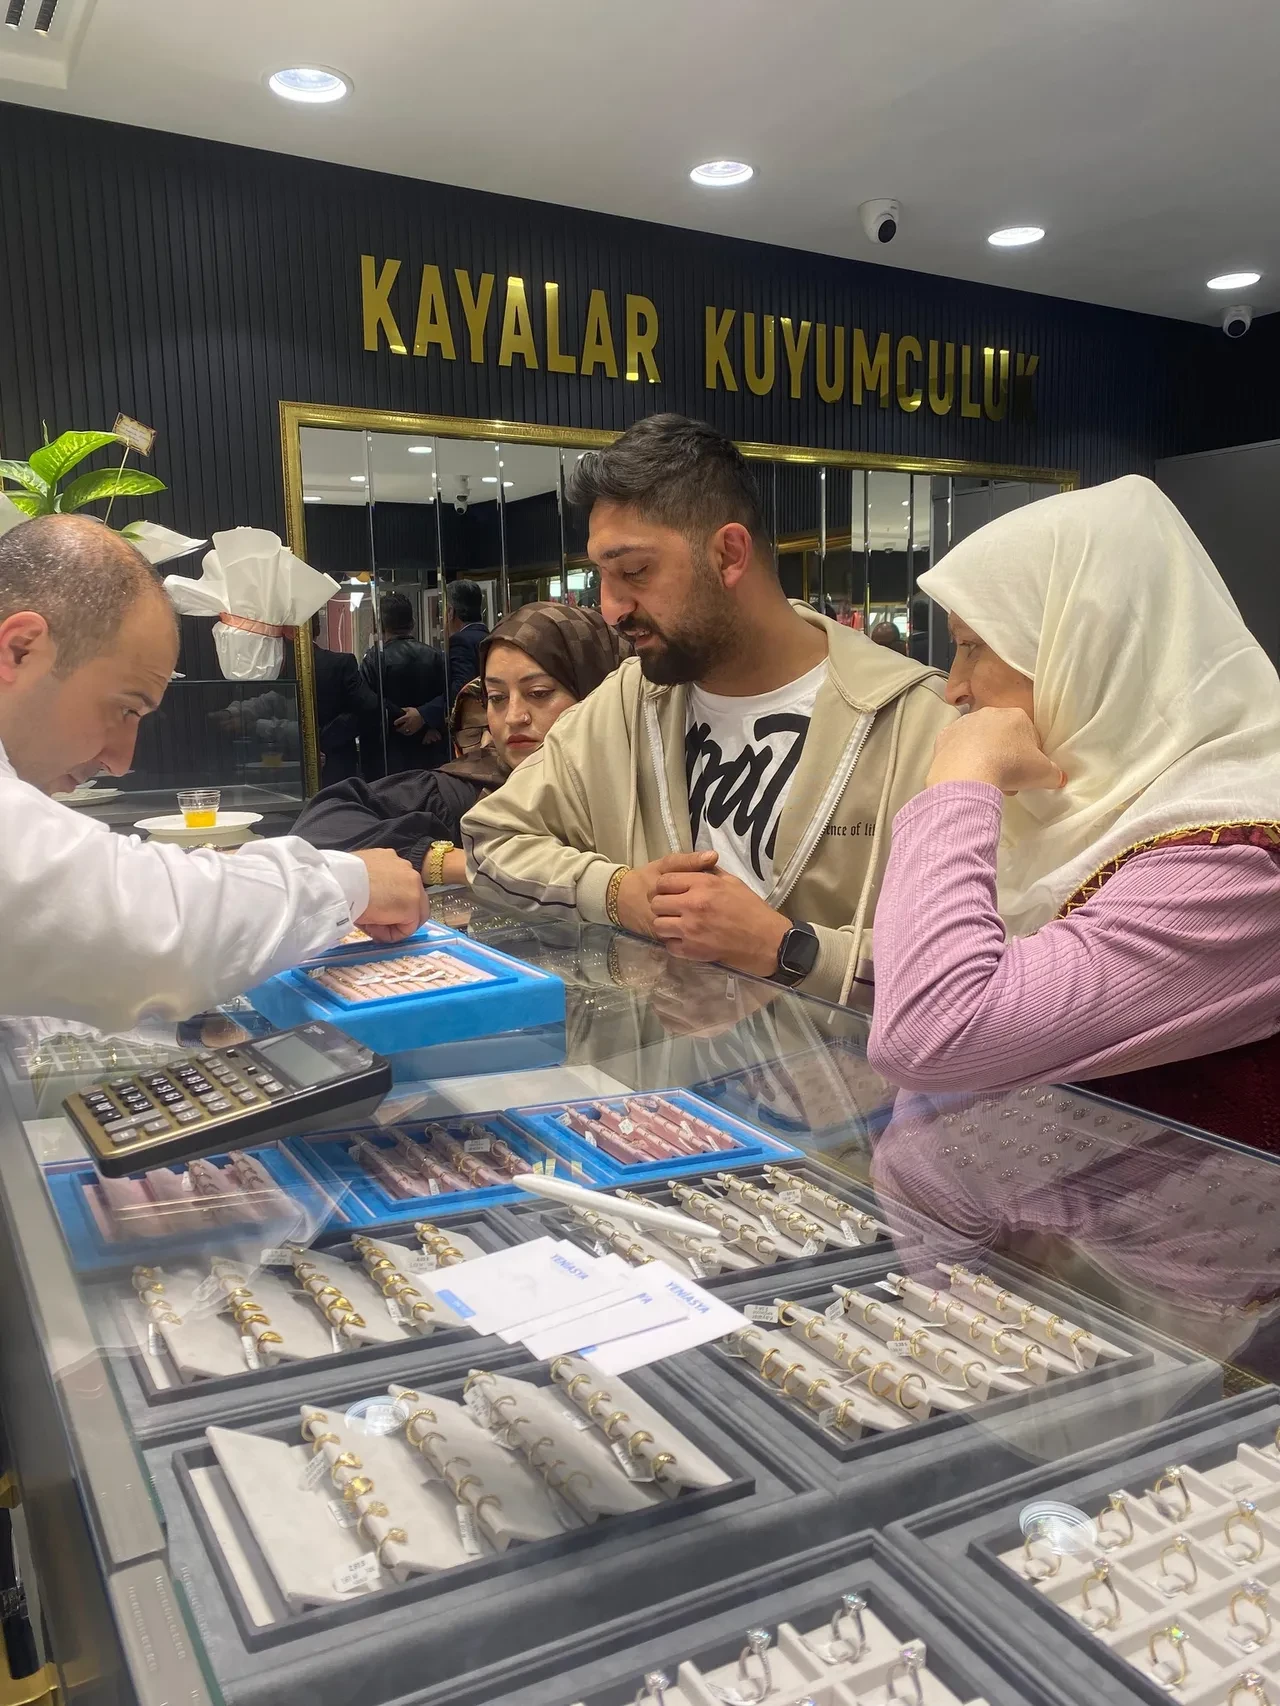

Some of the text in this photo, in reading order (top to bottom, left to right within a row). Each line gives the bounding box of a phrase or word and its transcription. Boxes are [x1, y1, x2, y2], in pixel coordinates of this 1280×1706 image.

[361, 254, 1040, 423] KAYALAR KUYUMCULUK
[850, 821, 861, 836] of
